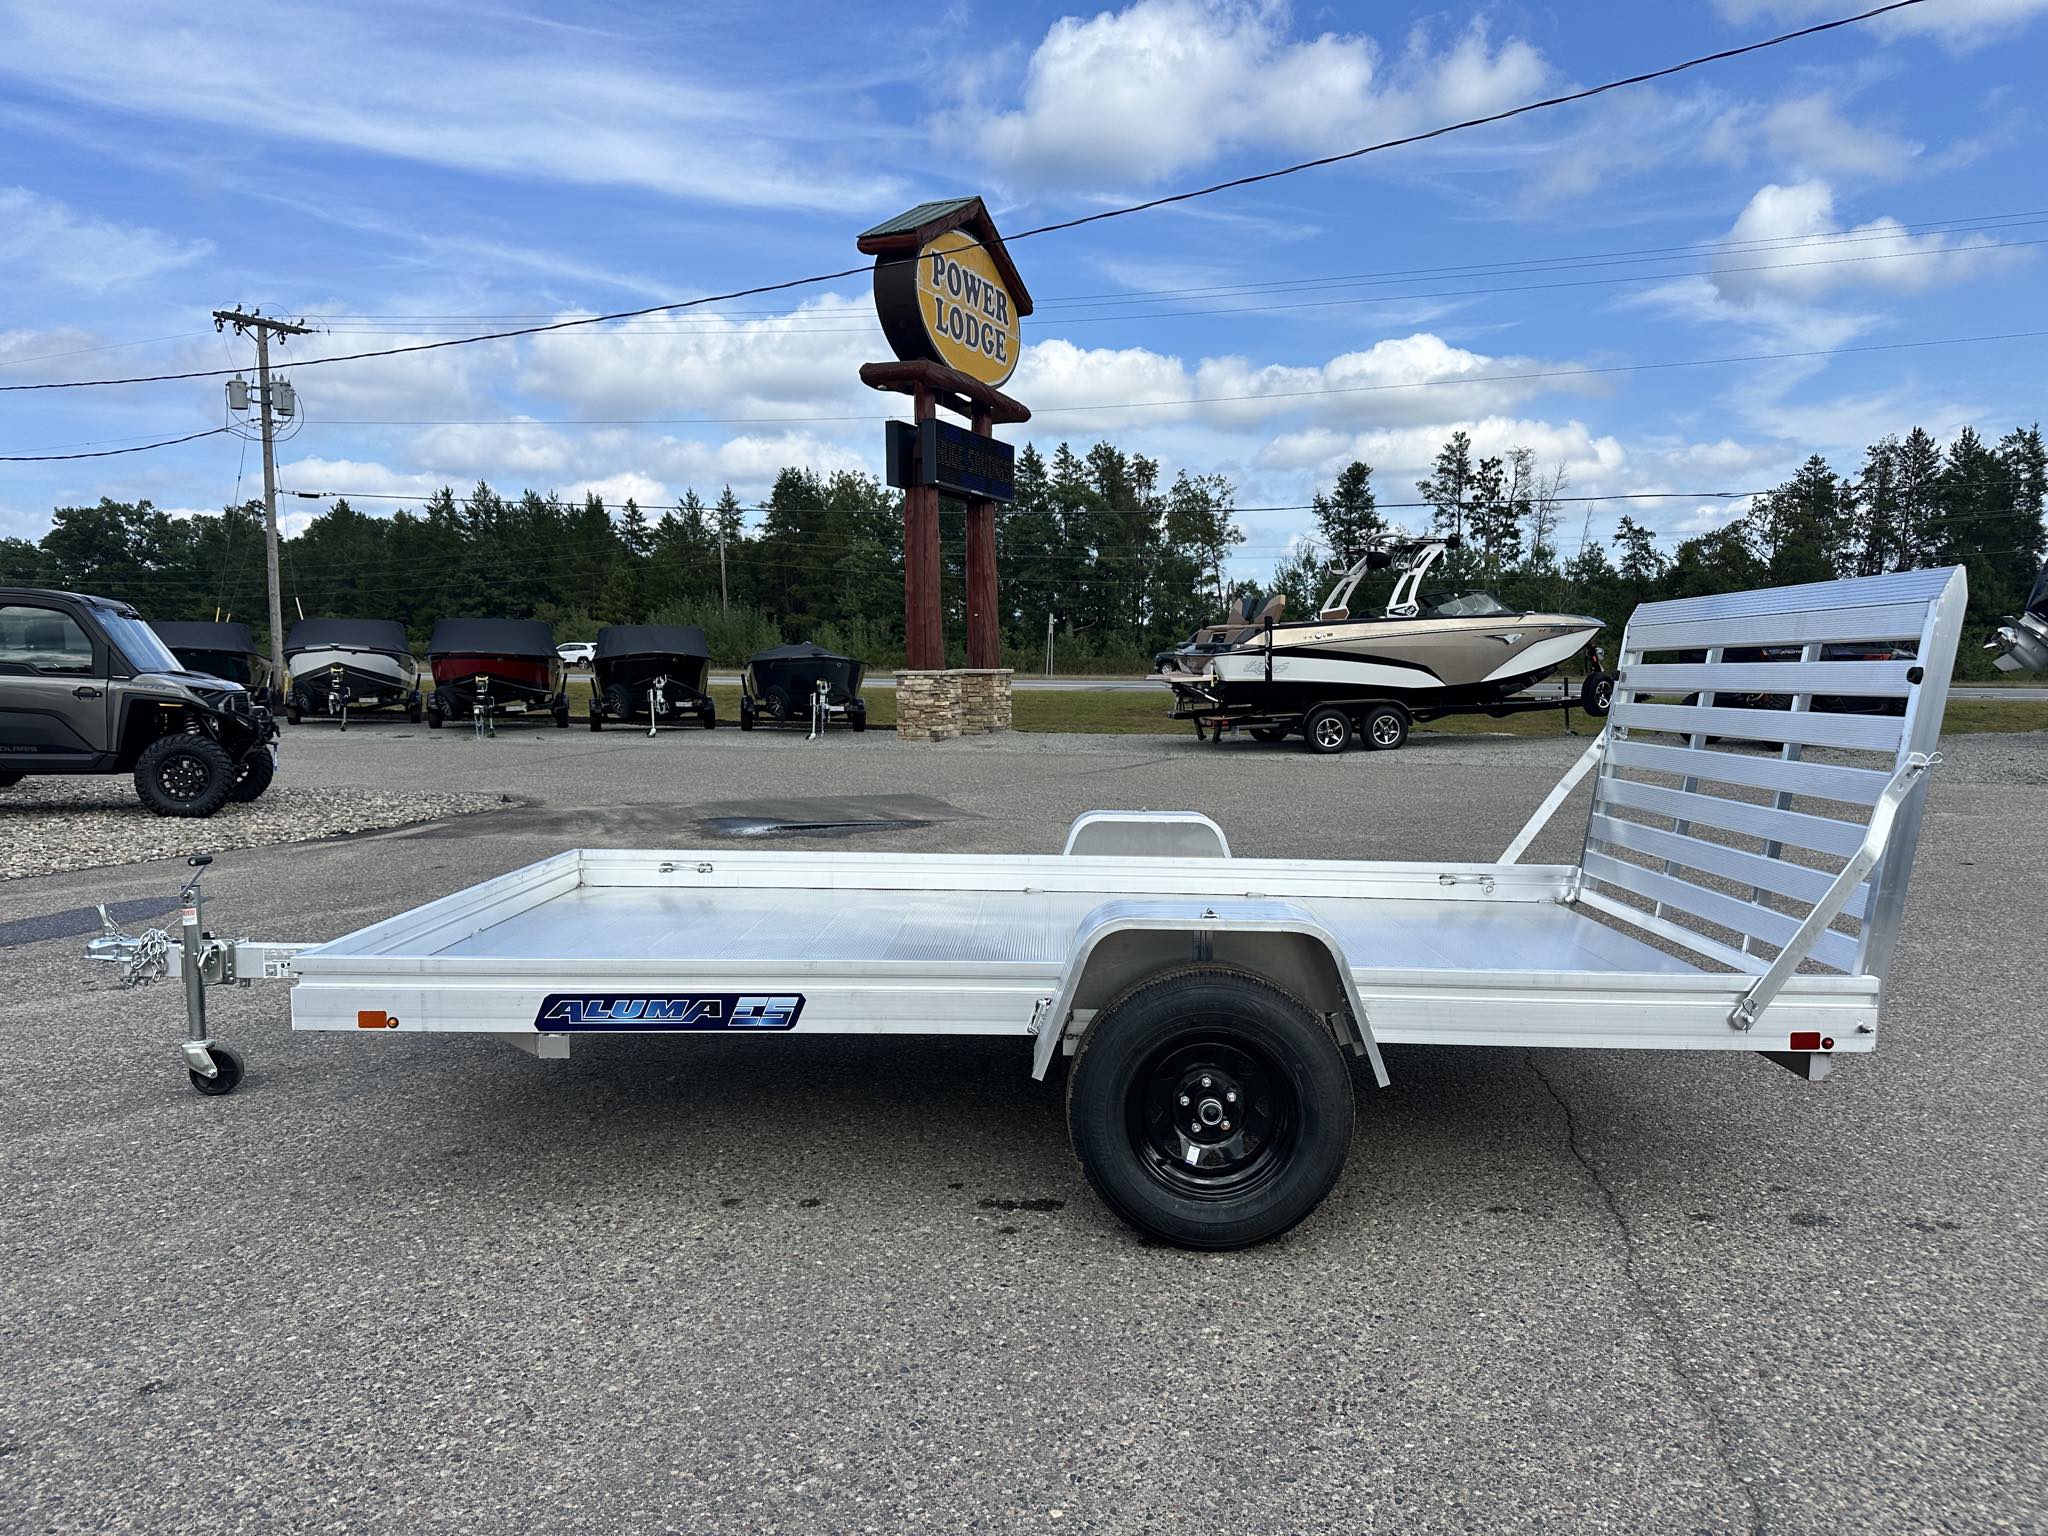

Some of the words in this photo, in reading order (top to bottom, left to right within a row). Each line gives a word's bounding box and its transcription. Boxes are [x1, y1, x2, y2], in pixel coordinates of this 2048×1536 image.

[931, 250, 1009, 326] POWER
[935, 296, 1007, 363] LODGE
[544, 1000, 722, 1024] ALUMA
